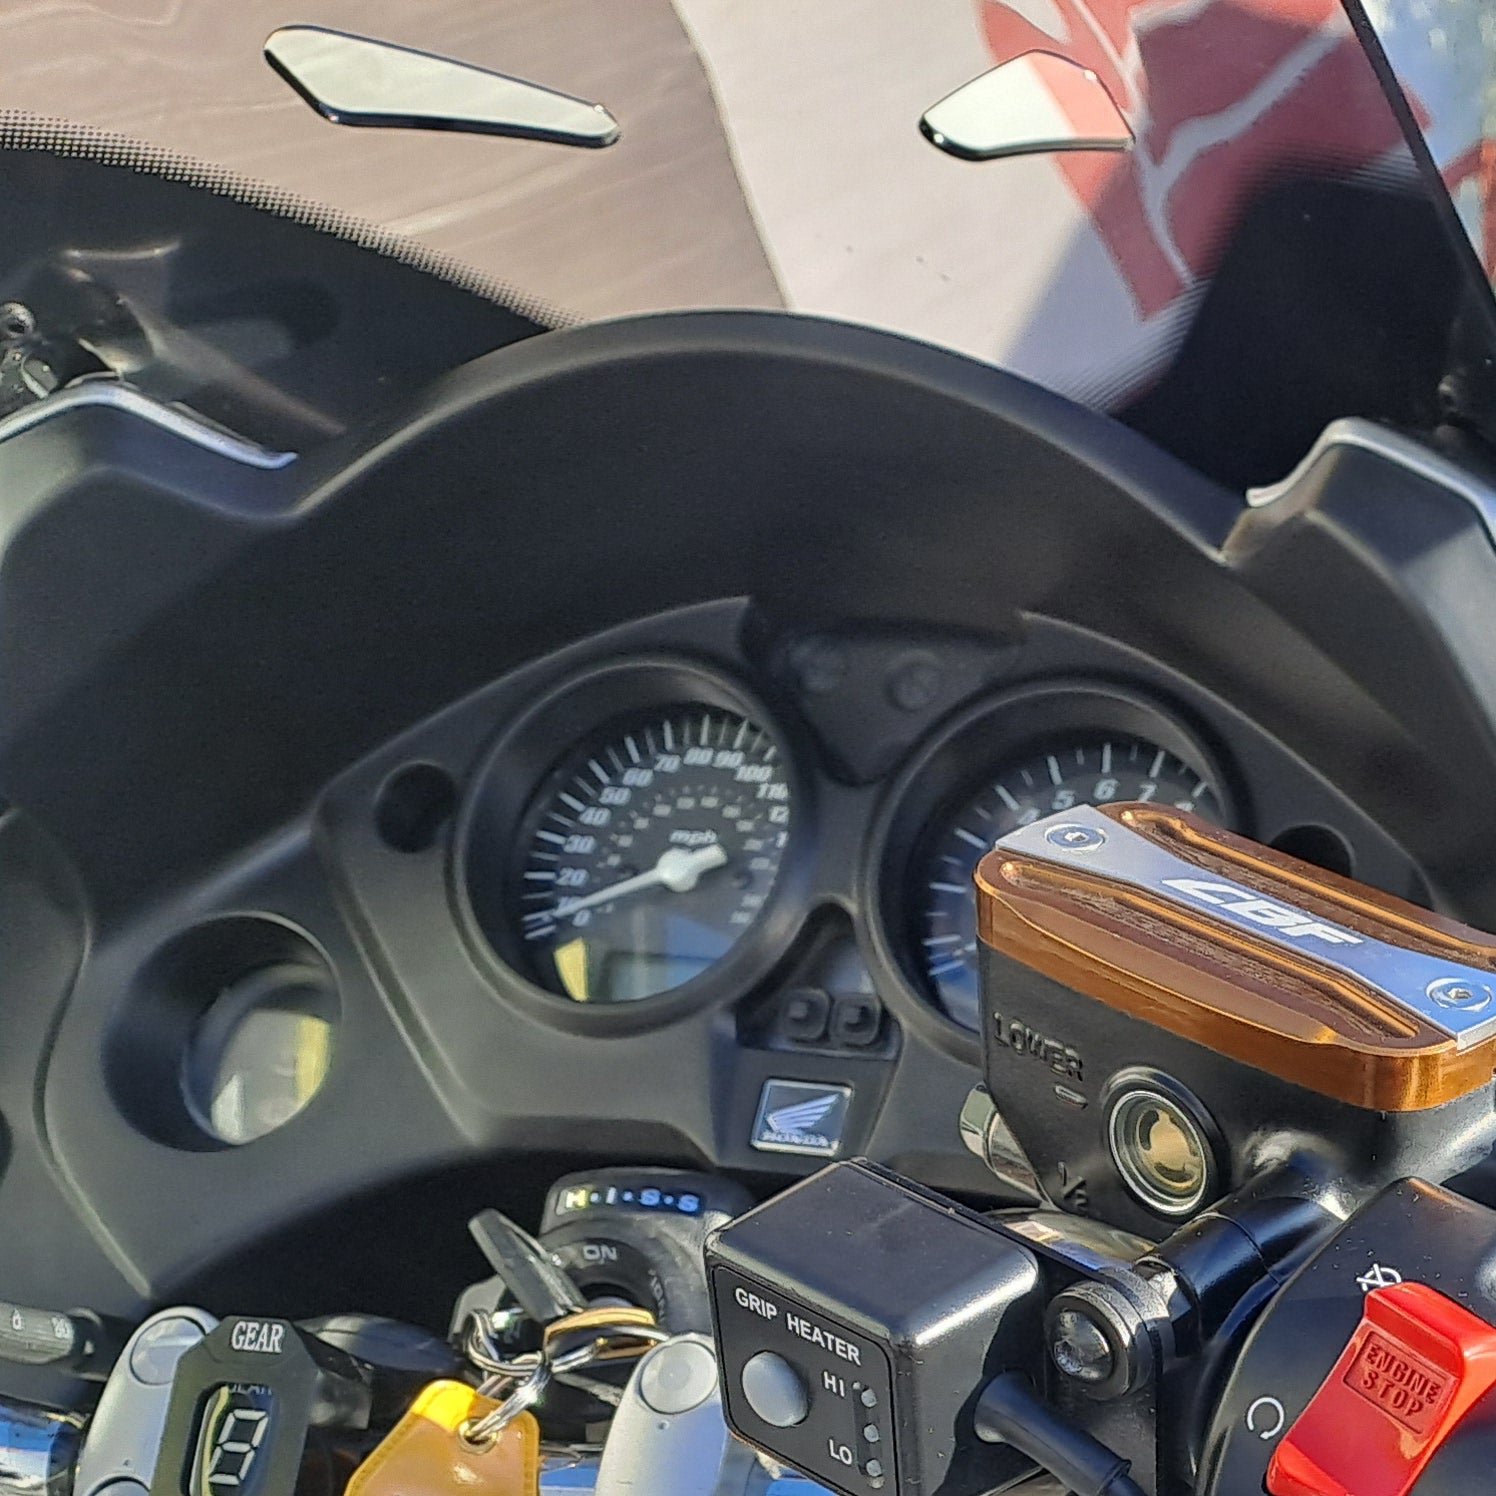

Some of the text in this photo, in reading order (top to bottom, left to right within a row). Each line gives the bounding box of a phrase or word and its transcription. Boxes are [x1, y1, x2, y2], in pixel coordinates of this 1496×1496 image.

[653, 753, 682, 773] 70
[599, 785, 632, 806] 50
[1052, 789, 1076, 811] 5
[1093, 777, 1120, 801] 6
[579, 806, 612, 827] 40
[563, 834, 597, 854] 30
[669, 829, 718, 846] mph
[555, 867, 590, 887] 20
[1161, 878, 1365, 945] CBF
[993, 1010, 1085, 1083] LOWER
[583, 1244, 618, 1261] ON
[231, 1320, 285, 1354] GEAR
[734, 1287, 862, 1367] GRIP HEATER
[822, 1370, 846, 1398] HI
[1365, 1343, 1442, 1405] ENGINE
[1362, 1370, 1424, 1417] STOP
[828, 1438, 853, 1466] LO
